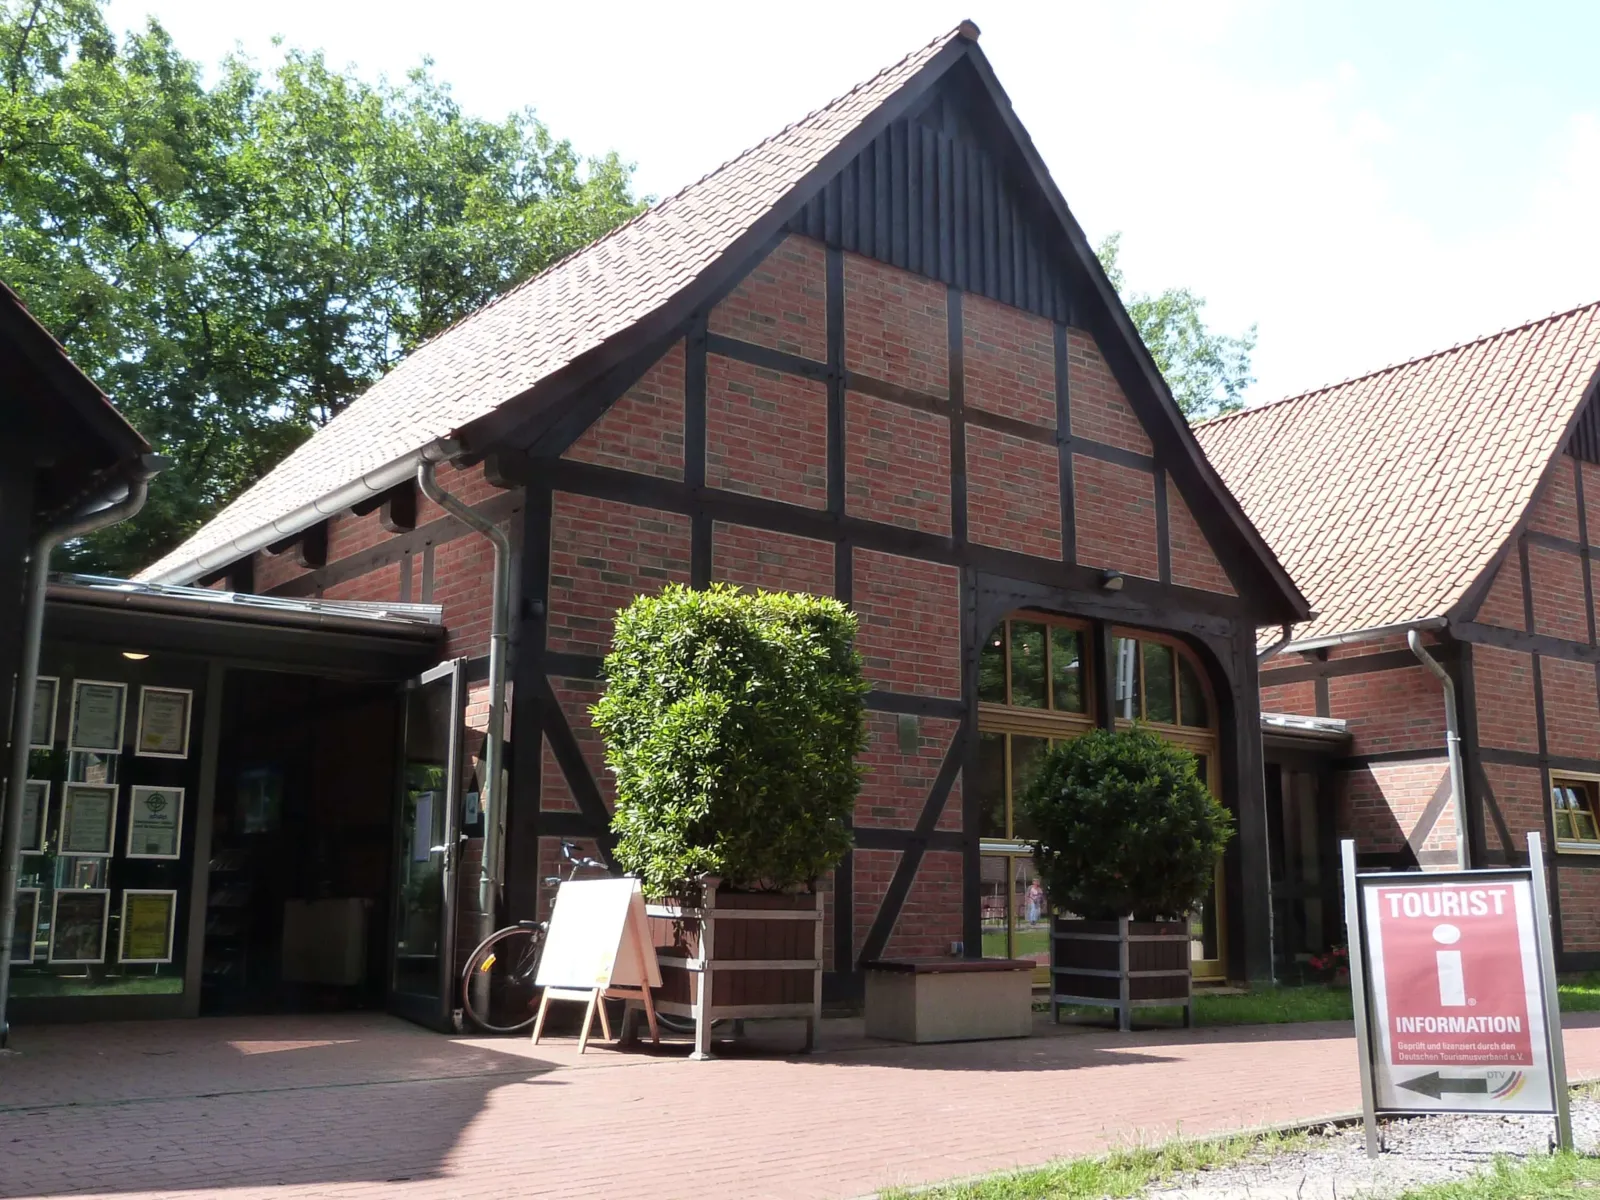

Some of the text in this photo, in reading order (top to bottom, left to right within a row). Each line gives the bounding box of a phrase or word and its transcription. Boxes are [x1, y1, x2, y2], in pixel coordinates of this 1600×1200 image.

[1385, 889, 1507, 918] TOURIST
[1395, 1016, 1521, 1033] INFORMATION
[1397, 1041, 1516, 1051] Geprüft und lizenziert durch den
[1440, 1053, 1508, 1061] Tourismusverband
[1486, 1071, 1506, 1080] DTV
